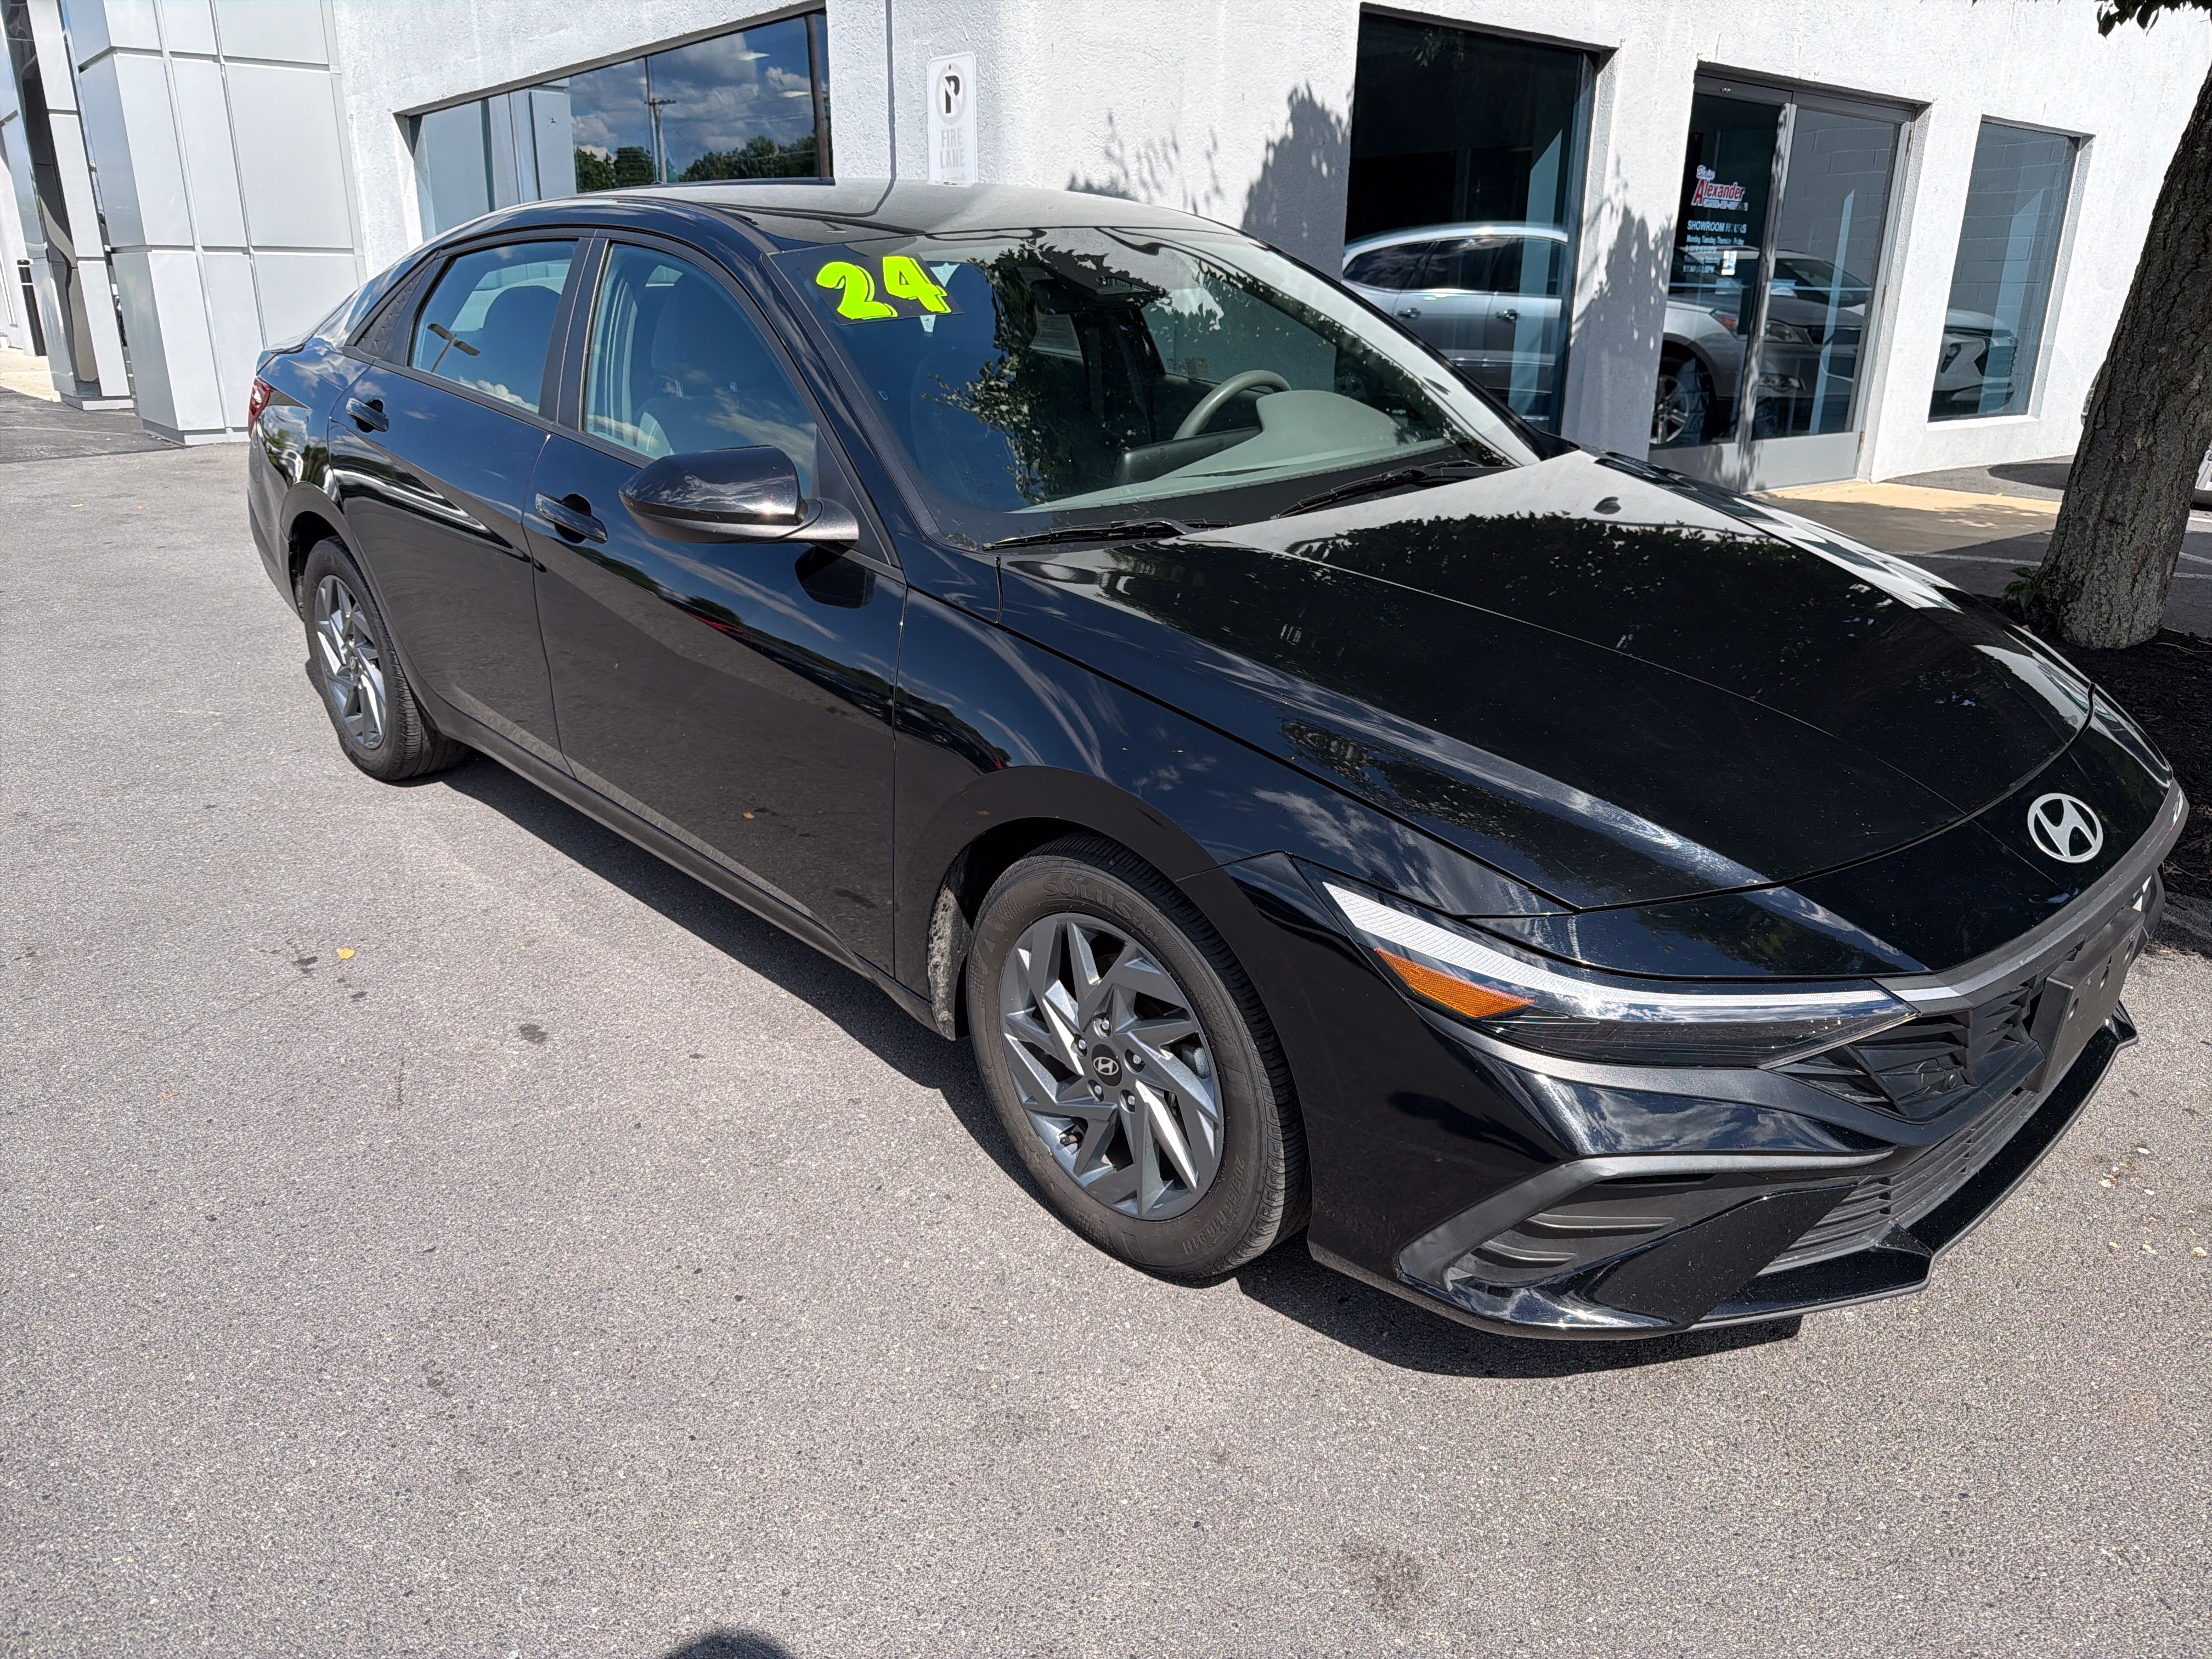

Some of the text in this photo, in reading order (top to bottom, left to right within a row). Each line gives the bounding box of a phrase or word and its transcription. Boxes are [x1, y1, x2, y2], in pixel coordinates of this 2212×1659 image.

[940, 127, 963, 148] FIRE
[939, 149, 964, 169] LANE
[1693, 179, 1745, 205] Alexander
[1687, 220, 1725, 232] SHOWROOM
[816, 256, 952, 320] 24
[1043, 880, 1132, 920] SOLUS
